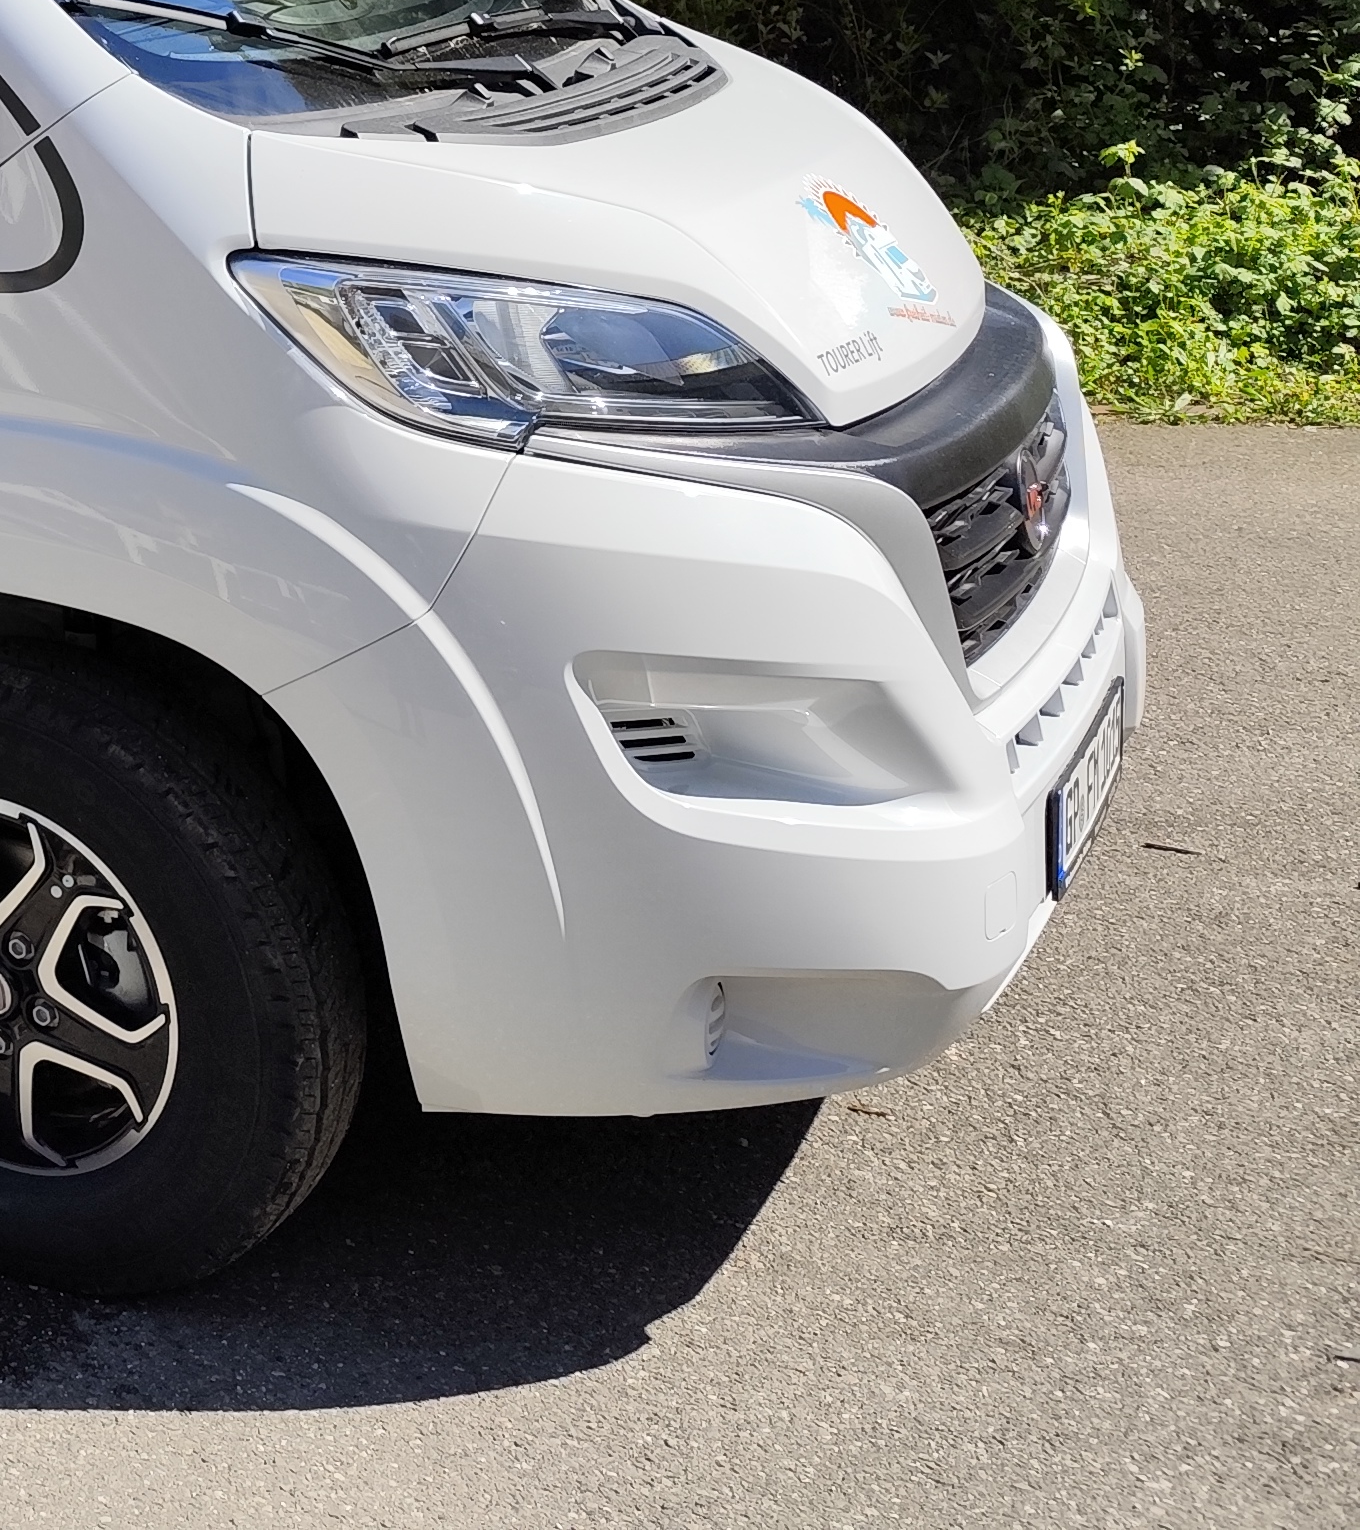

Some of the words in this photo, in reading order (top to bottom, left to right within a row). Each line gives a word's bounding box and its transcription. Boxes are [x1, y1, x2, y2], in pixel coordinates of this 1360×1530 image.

[817, 340, 866, 376] TOURER
[859, 331, 883, 361] Lift
[1066, 777, 1079, 856] GP
